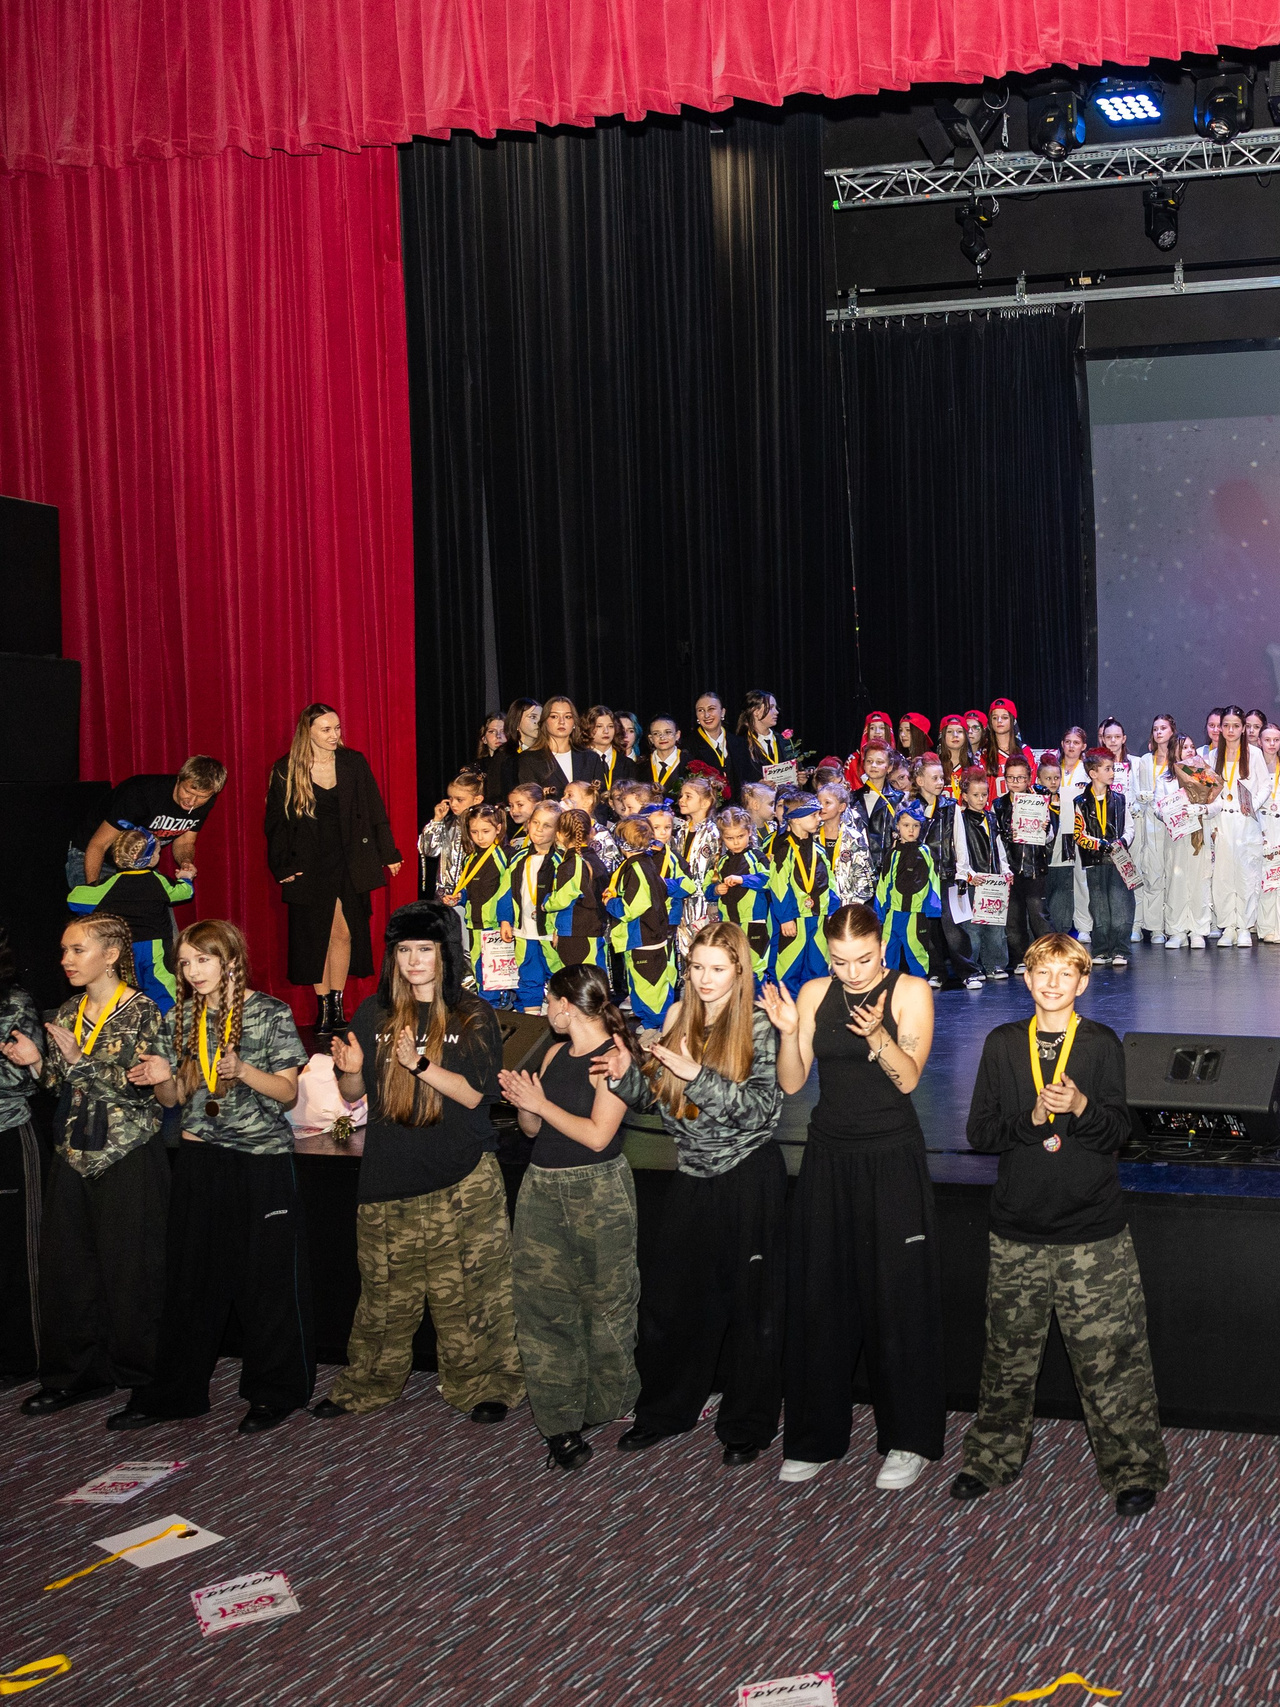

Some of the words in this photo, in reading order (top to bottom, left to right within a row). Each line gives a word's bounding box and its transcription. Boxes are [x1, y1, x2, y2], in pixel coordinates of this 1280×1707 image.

[767, 765, 793, 775] DYPLOM
[1018, 798, 1046, 806] DYPLOM
[1018, 817, 1040, 830] LEO
[980, 898, 1002, 910] LEO
[204, 1574, 275, 1599] DYPLOM
[750, 1679, 824, 1699] DYPLOM
